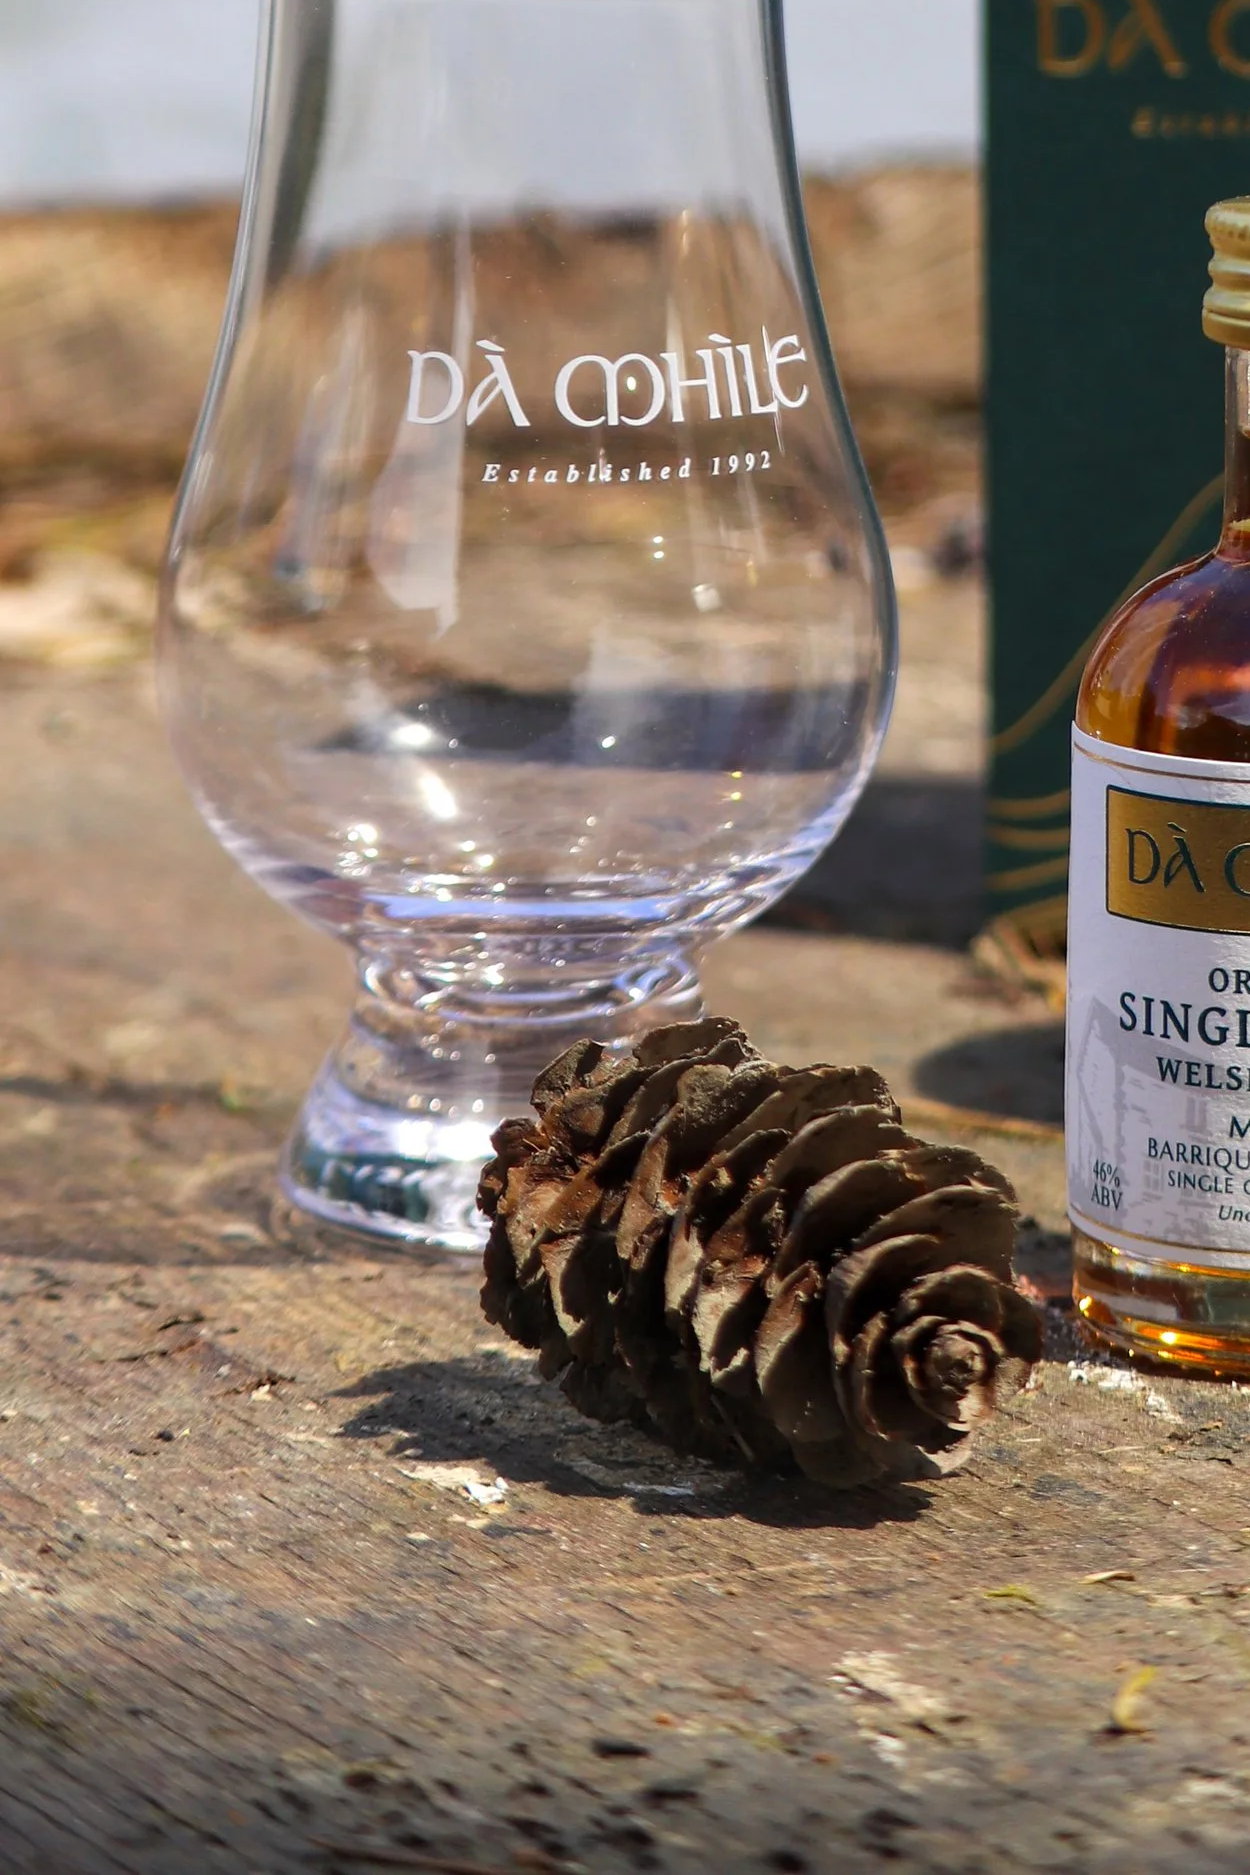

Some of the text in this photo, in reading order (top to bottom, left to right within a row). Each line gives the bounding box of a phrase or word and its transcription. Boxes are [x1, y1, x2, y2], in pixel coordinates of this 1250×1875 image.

[406, 339, 532, 427] DÀ
[482, 450, 772, 485] Established 1992
[1125, 821, 1207, 894] DÀ
[1092, 1157, 1121, 1188] 46%
[1167, 1169, 1234, 1195] SINGLE
[1090, 1185, 1123, 1212] ABV
